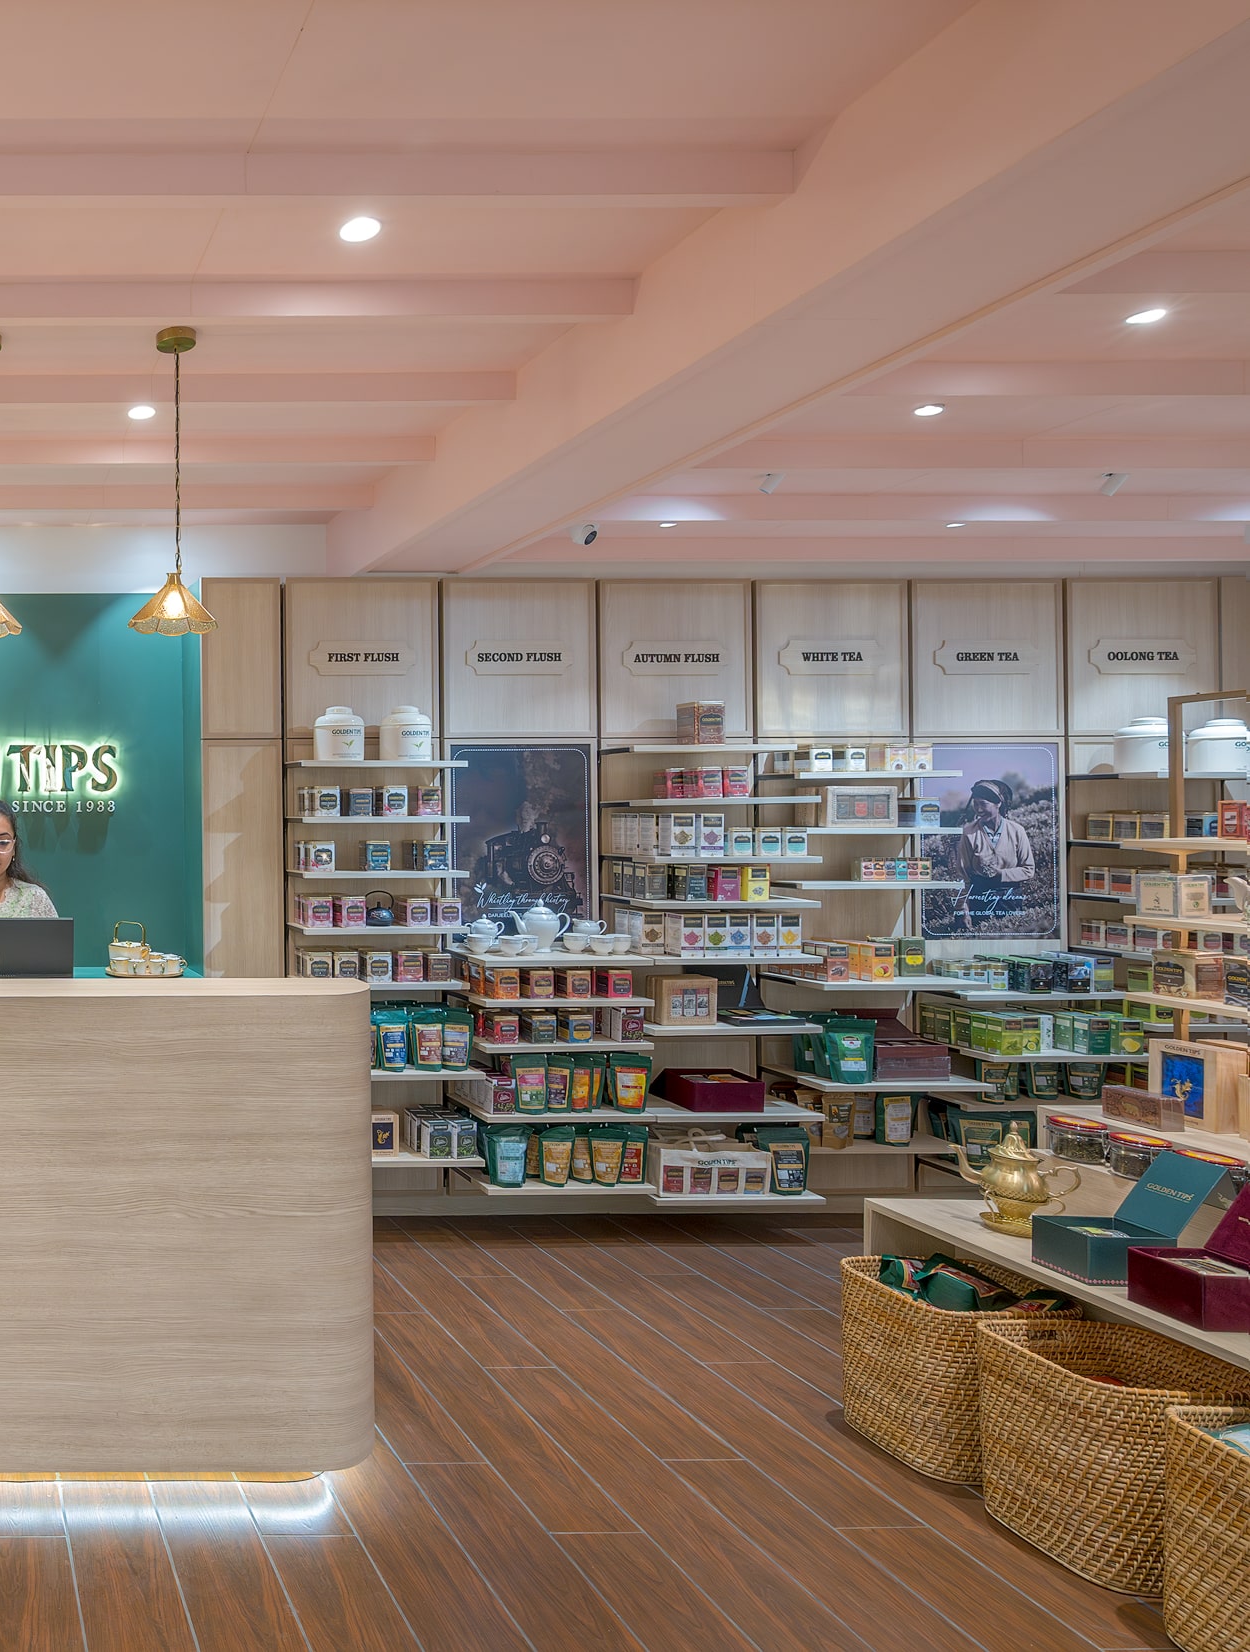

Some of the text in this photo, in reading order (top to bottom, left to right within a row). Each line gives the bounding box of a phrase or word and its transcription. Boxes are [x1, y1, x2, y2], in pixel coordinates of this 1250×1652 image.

[327, 652, 400, 663] FIRST FLUSH
[477, 652, 562, 663] SECOND FLUSH
[633, 653, 720, 663] AUTUMN FLUSH
[801, 651, 863, 662] WHITE TEA
[956, 651, 1020, 662] GREEN TEA
[1107, 651, 1180, 662] OOLONG TEA
[6, 743, 119, 793] TIPS
[12, 800, 67, 813] SINCE
[1164, 1044, 1188, 1053] GOLDEN
[1146, 1182, 1192, 1202] GOLDEN TIPS
